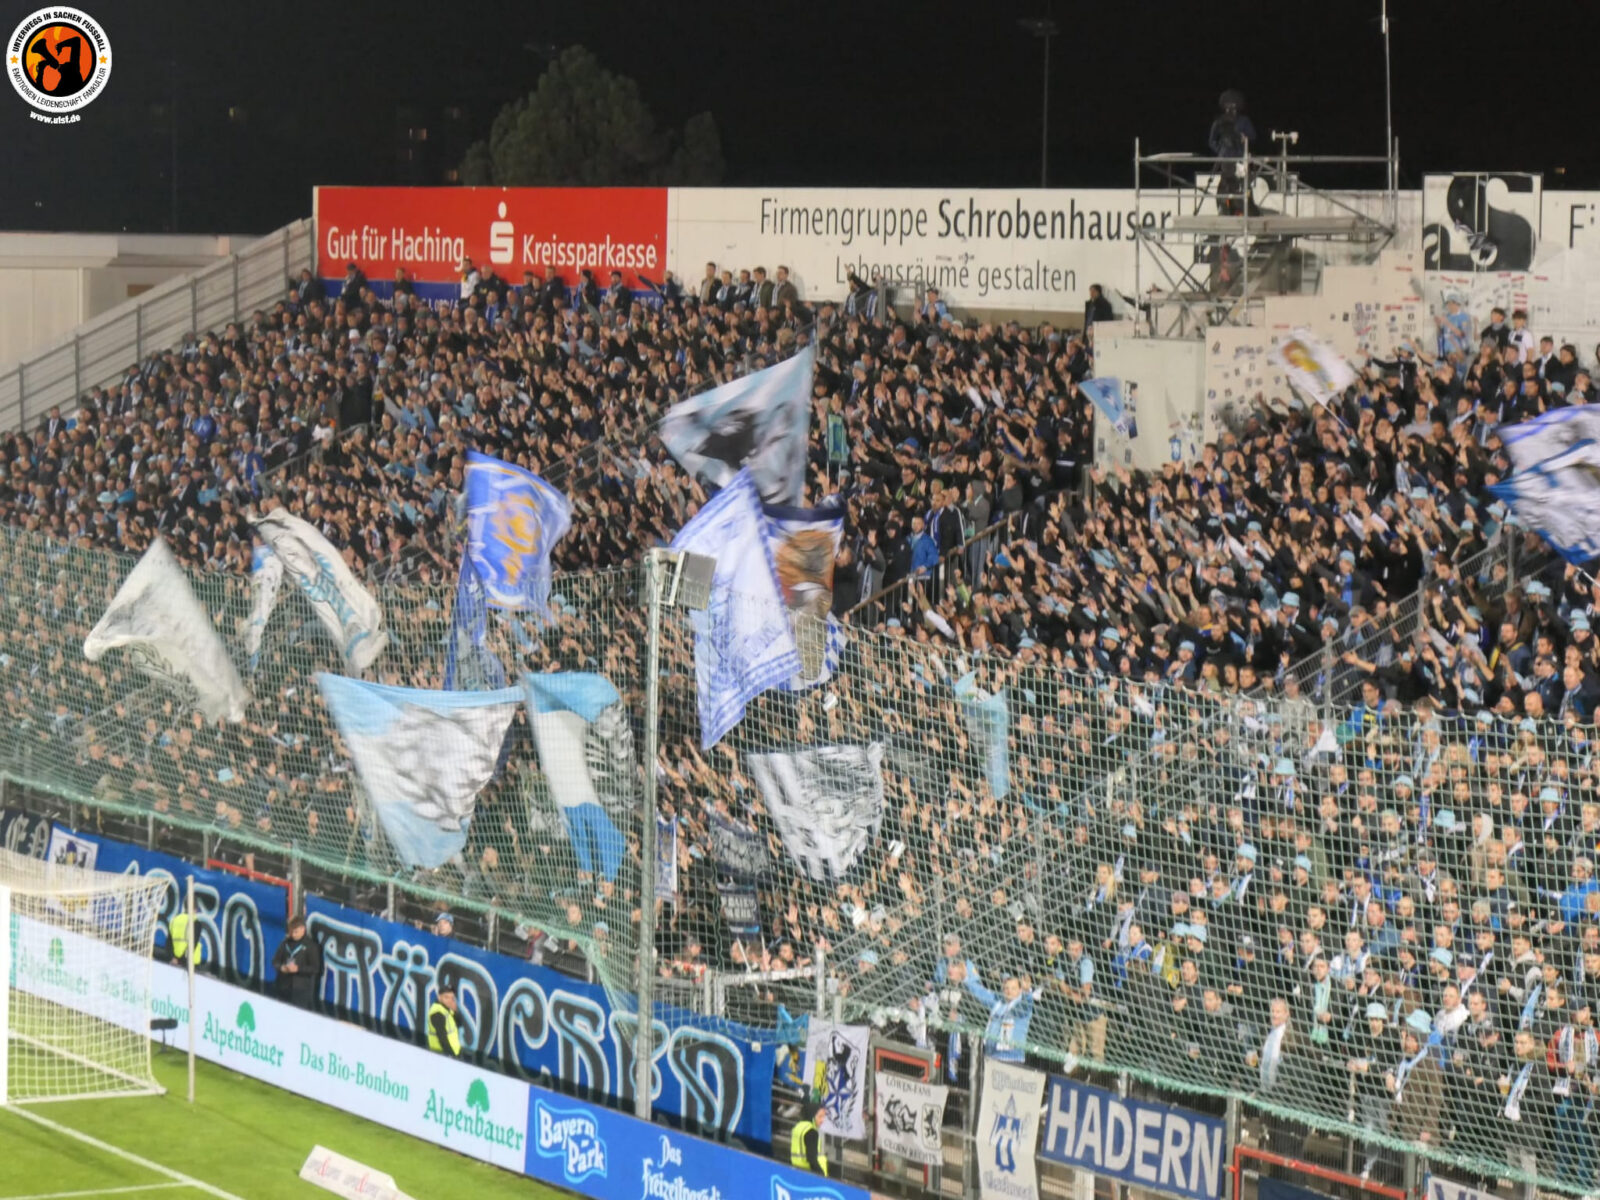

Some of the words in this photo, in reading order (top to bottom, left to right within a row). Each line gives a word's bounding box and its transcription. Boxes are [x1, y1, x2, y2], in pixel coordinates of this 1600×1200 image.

[327, 227, 359, 261] Gut
[361, 225, 387, 261] für
[760, 198, 929, 246] Firmengruppe
[937, 199, 1172, 242] Schrobenhauser
[523, 232, 657, 274] Kreissparkasse
[977, 259, 1076, 297] gestalten
[202, 1011, 285, 1069] Alpenbauer
[299, 1042, 325, 1073] Das
[327, 1052, 410, 1102] Bio-Bonbon
[423, 1088, 524, 1151] Alpenbauer
[539, 1107, 596, 1150] Bayern
[567, 1136, 605, 1174] Park
[657, 1134, 682, 1169] Das
[1046, 1083, 1223, 1199] HADERN
